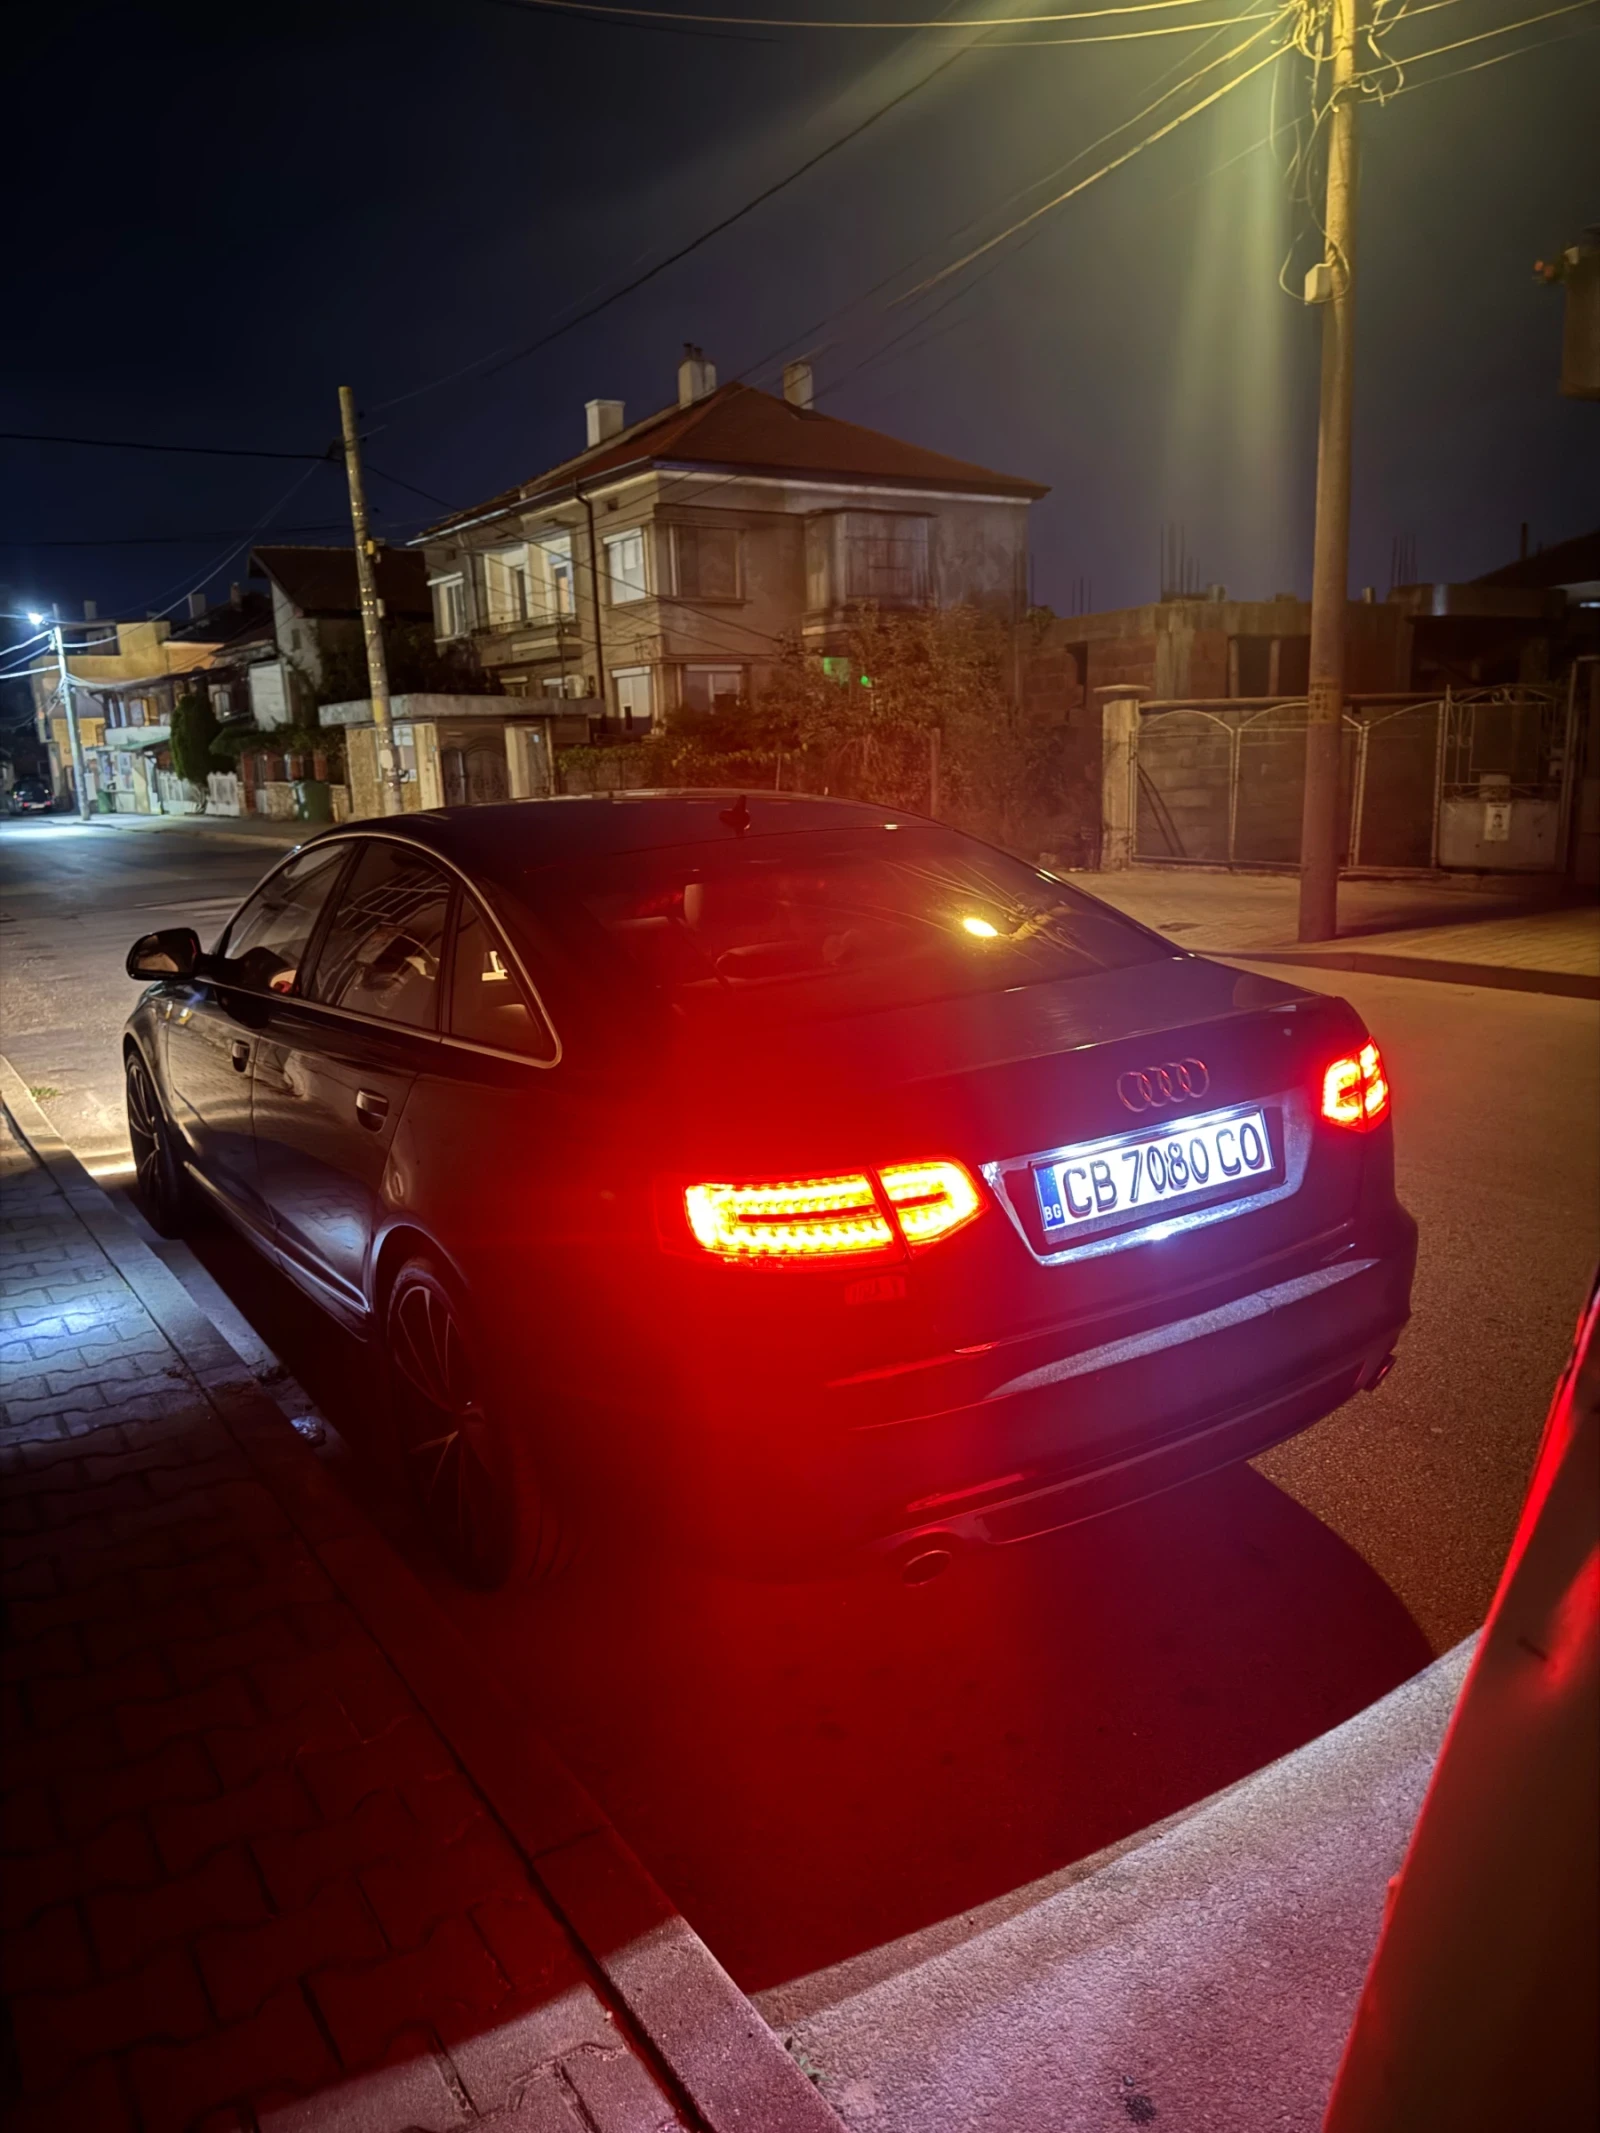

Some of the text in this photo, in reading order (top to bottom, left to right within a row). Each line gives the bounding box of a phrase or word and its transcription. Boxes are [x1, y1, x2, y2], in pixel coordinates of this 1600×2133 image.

[1063, 1123, 1263, 1217] CB 7080 CO
[1043, 1204, 1062, 1221] BG
